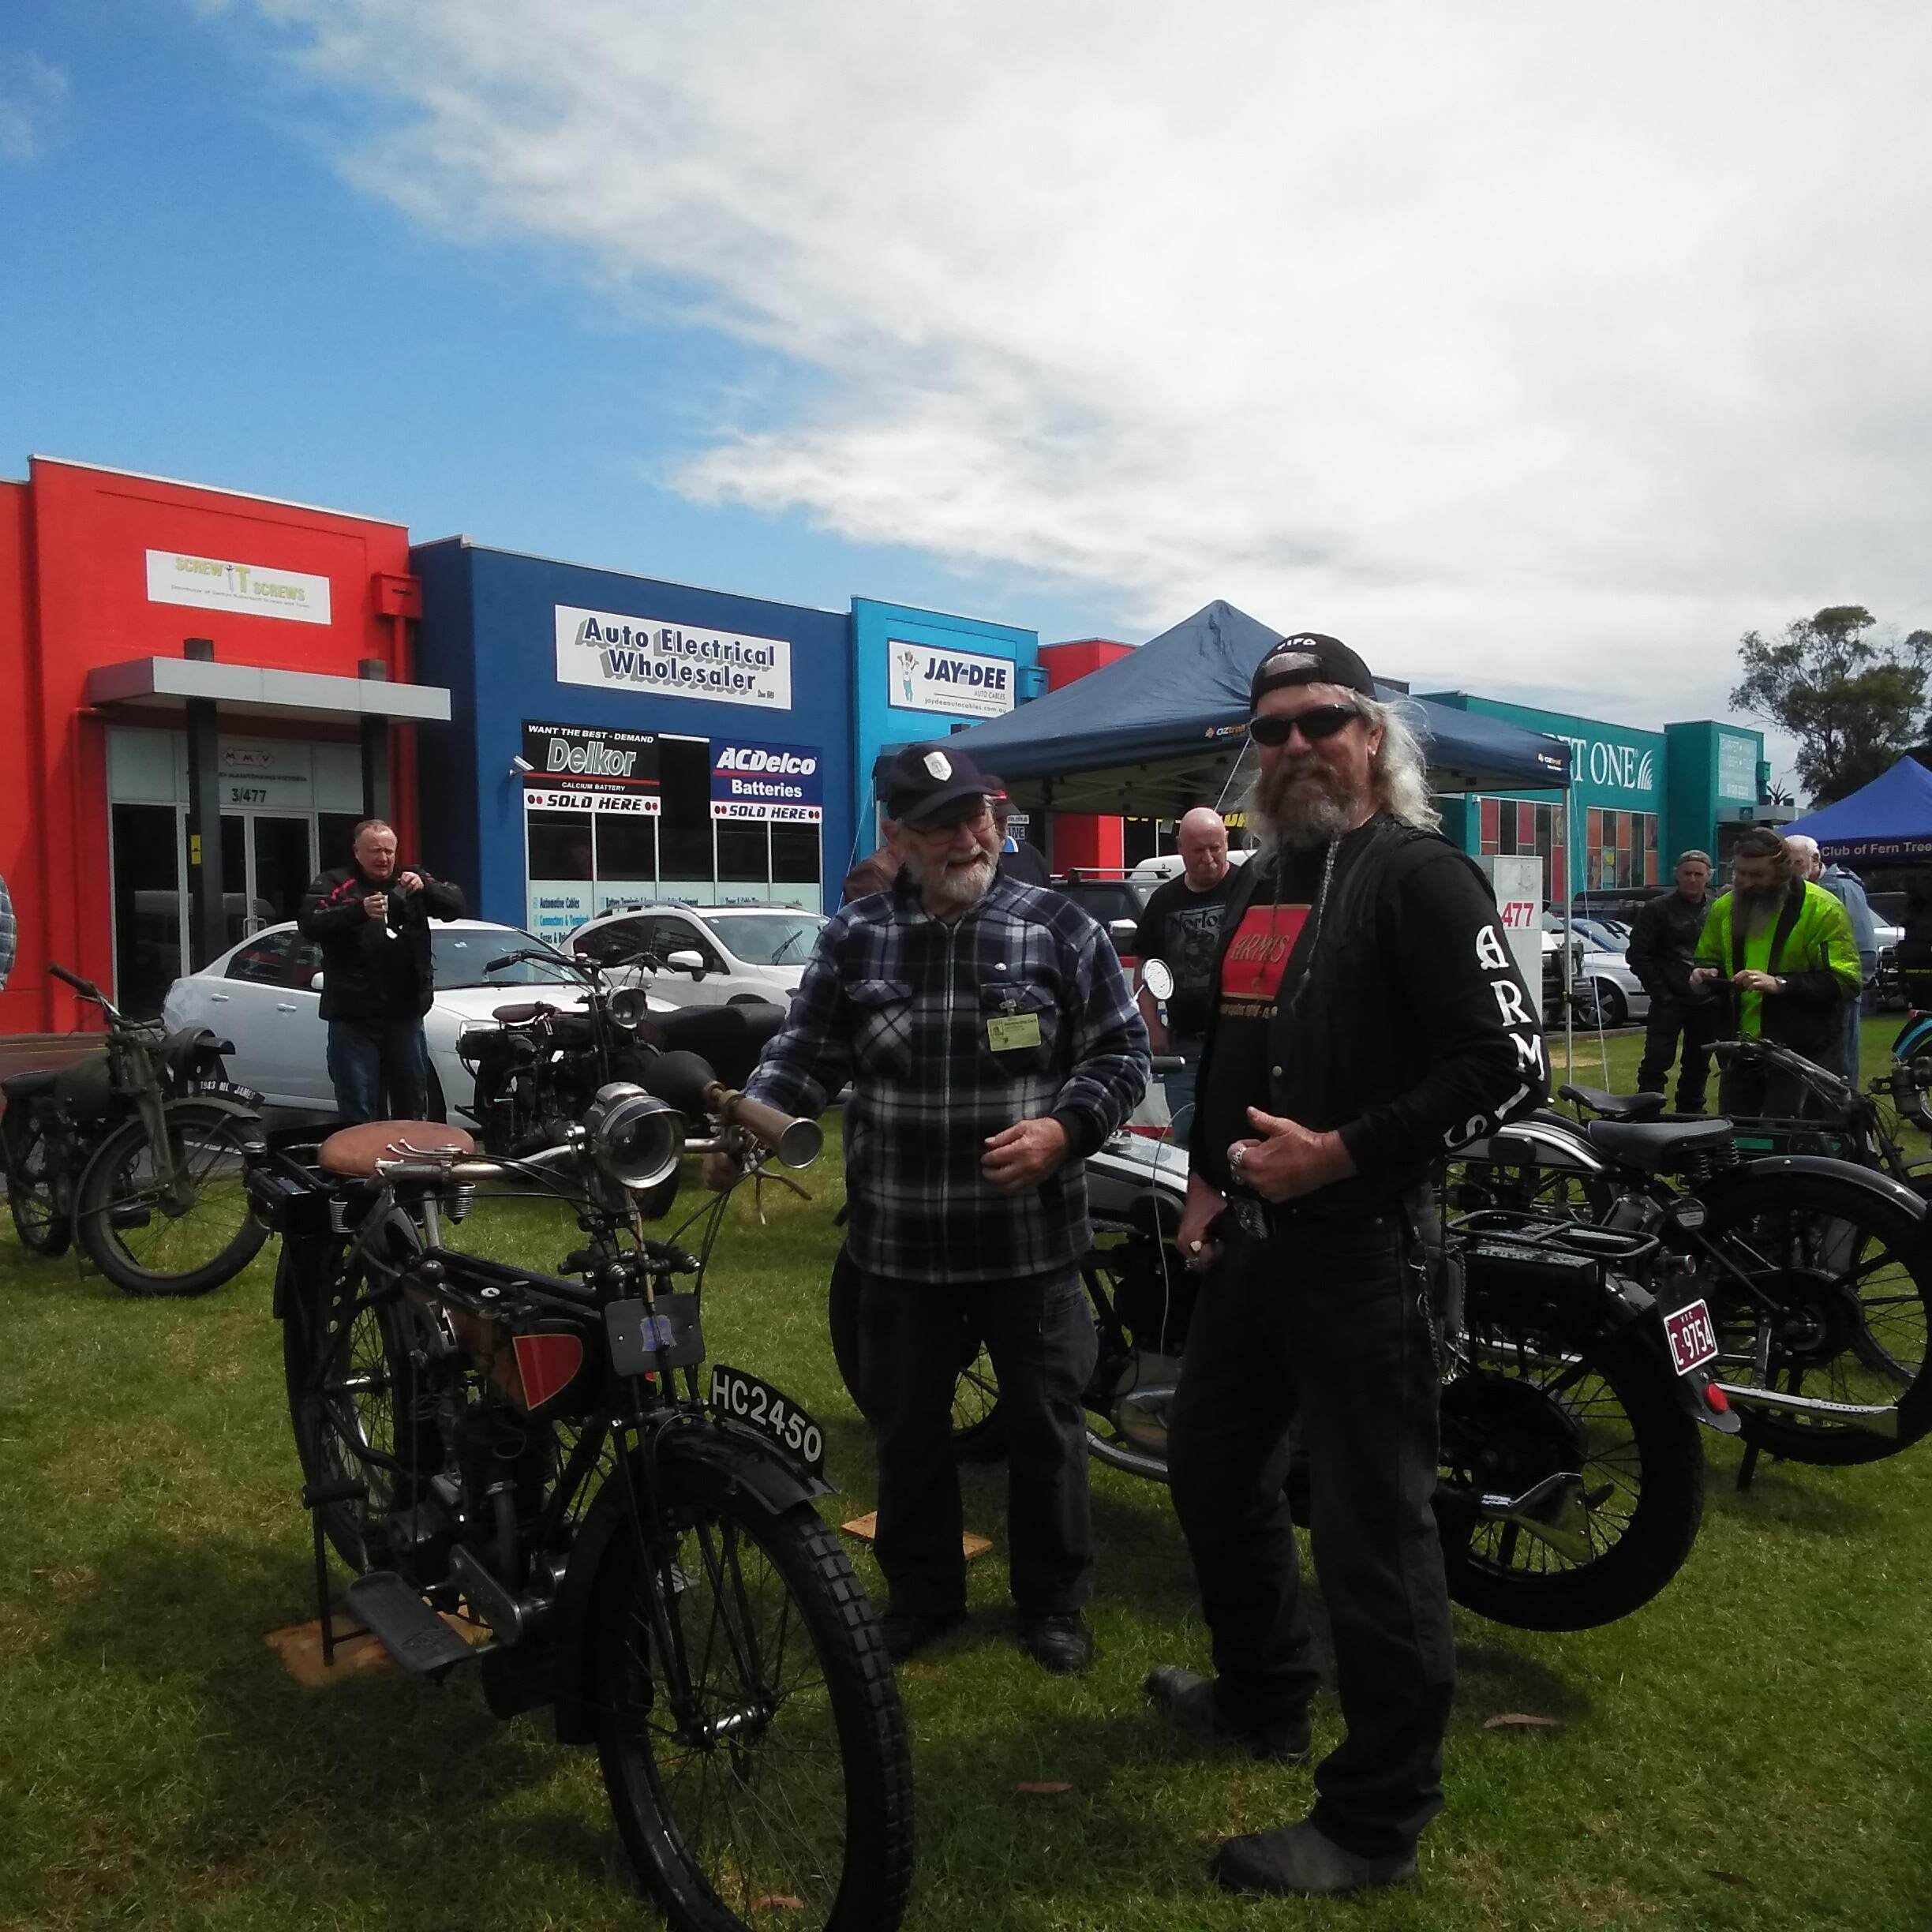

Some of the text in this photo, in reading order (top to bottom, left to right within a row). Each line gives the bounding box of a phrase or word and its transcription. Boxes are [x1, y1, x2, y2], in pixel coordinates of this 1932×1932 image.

[175, 556, 223, 577] SCREW
[253, 581, 305, 602] SCREWS
[580, 616, 775, 668] Auto Electrical
[605, 648, 756, 691] Wholesaler
[923, 657, 1006, 690] JAY-DEE
[528, 724, 560, 736] WANT
[561, 728, 580, 737] THE
[582, 730, 610, 739] BEST
[614, 733, 654, 743] DEMAND
[546, 737, 637, 777] Delkor
[716, 747, 816, 775] ACDelco
[1590, 741, 1635, 788] ONE
[231, 788, 267, 803] 3/477
[561, 781, 593, 790] CALCIUM
[732, 778, 803, 798] Batteries
[547, 794, 642, 811] SOLD HERE
[728, 805, 807, 820] SOLD HERE
[1822, 844, 1850, 857] Club
[1854, 844, 1868, 856] of
[1870, 843, 1899, 855] Fern
[1502, 901, 1534, 927] 477
[1679, 1311, 1693, 1324] VIC
[712, 1370, 822, 1463] HC2450
